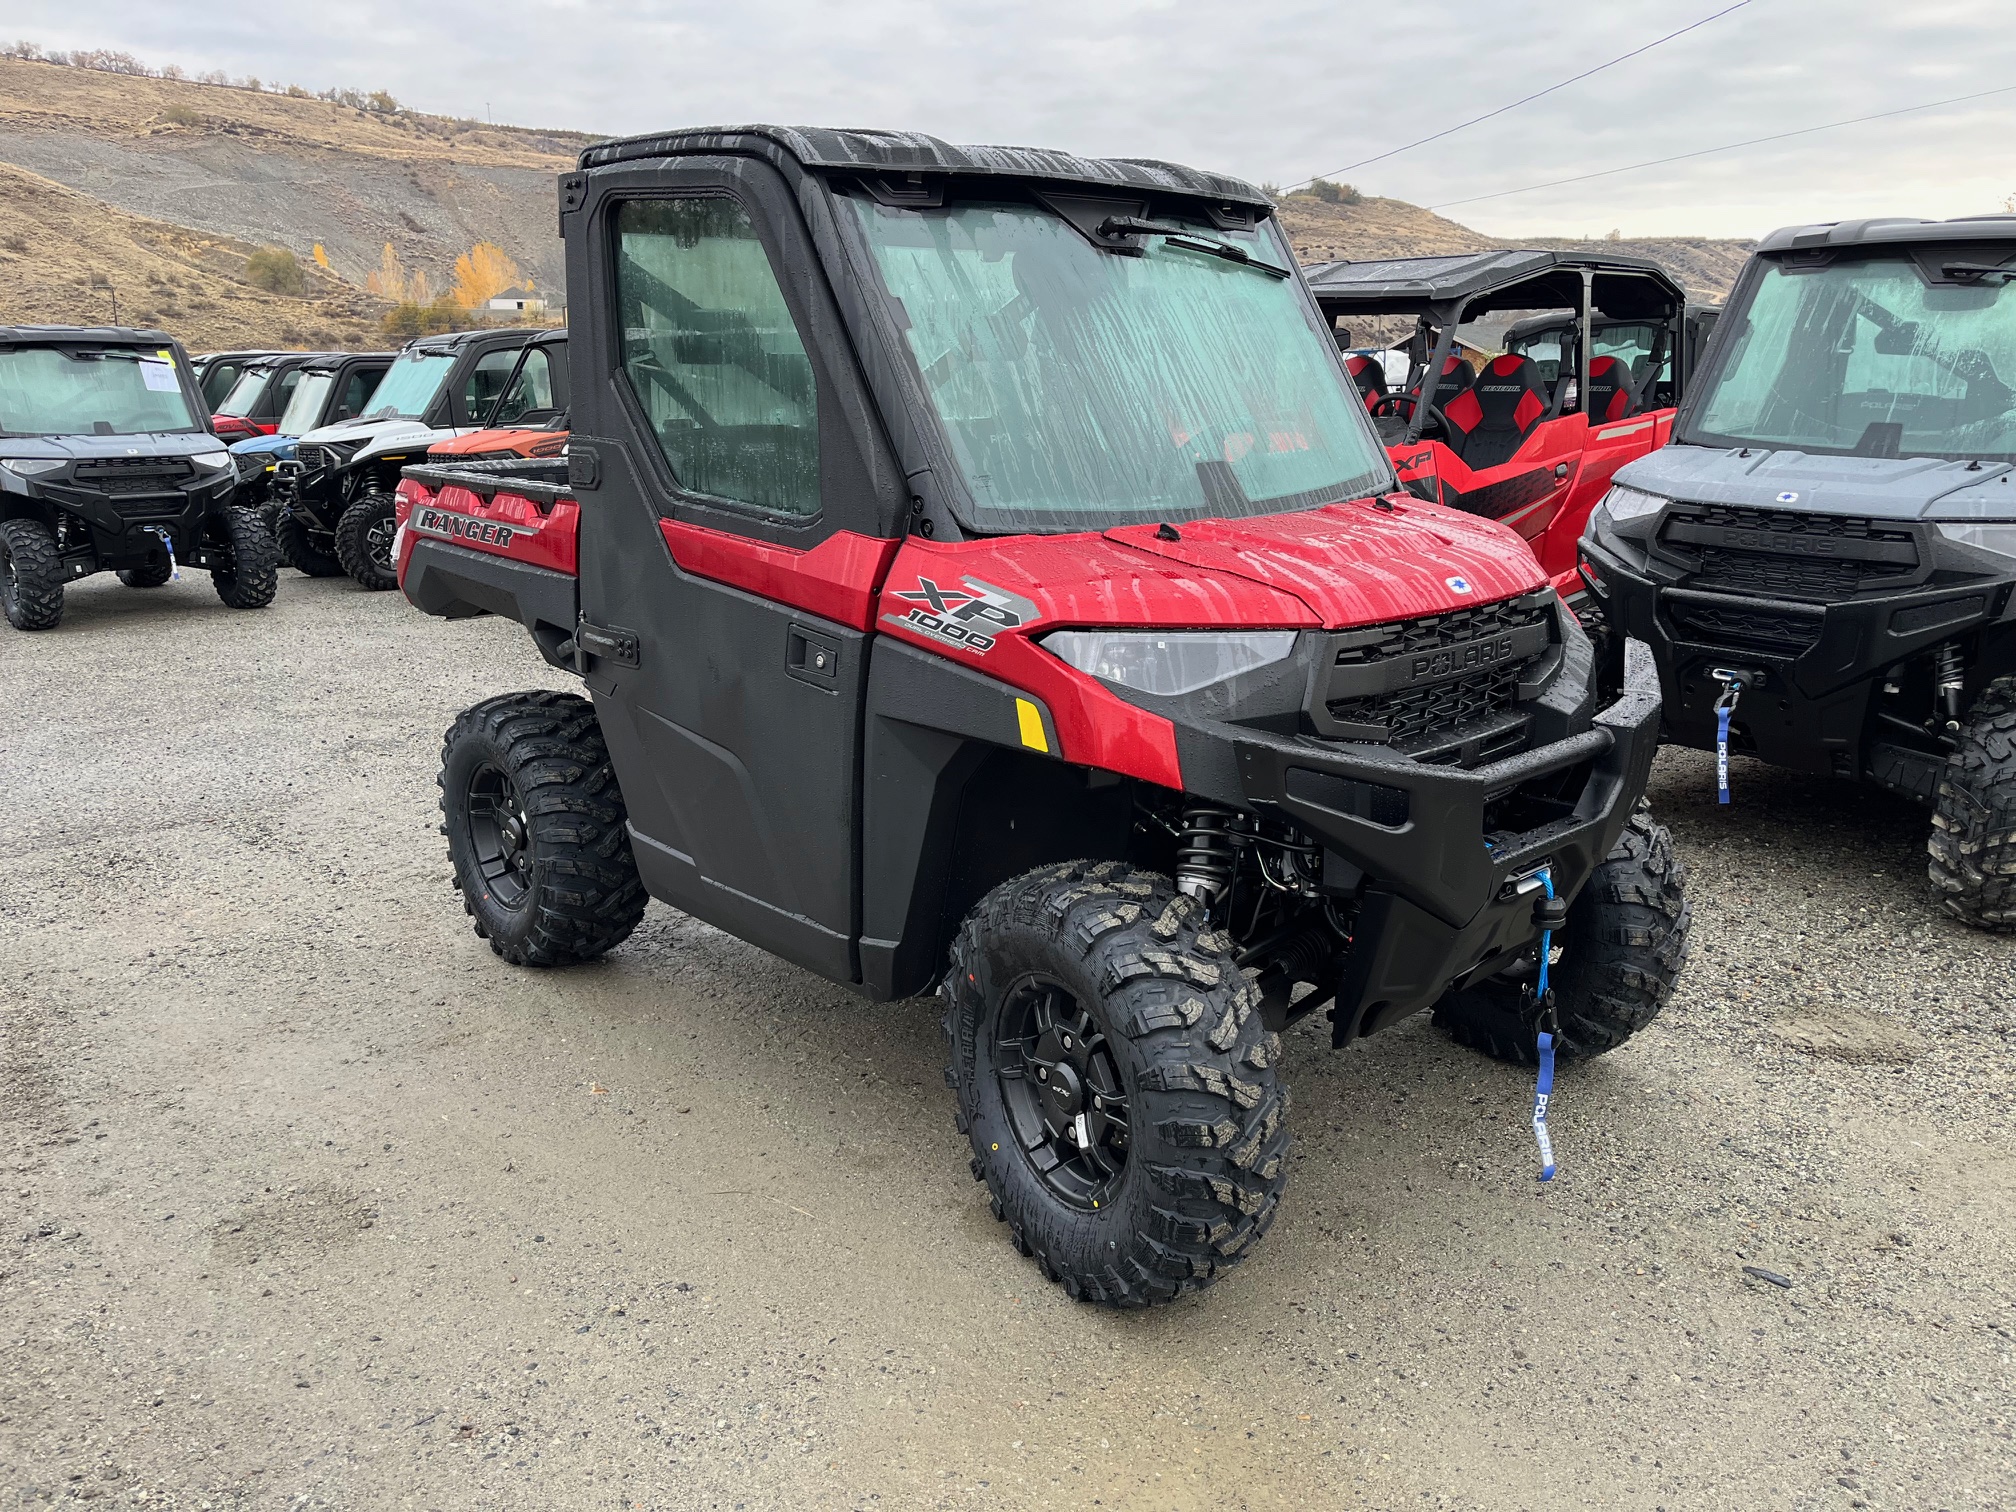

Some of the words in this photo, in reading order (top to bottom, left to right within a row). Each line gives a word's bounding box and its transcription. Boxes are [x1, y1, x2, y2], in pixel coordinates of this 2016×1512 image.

[396, 433, 434, 441] 1500
[532, 444, 562, 454] 1000
[109, 467, 163, 475] POLARIS
[1394, 450, 1432, 474] XP
[419, 508, 514, 549] RANGER
[1723, 530, 1837, 555] POLARIS
[889, 575, 1022, 628] XP
[904, 622, 924, 633] DUAL
[924, 630, 966, 649] OVERHEAD
[966, 647, 986, 657] CAM
[906, 607, 996, 652] 1000
[1411, 635, 1514, 681] POLARIS
[1718, 741, 1728, 790] POLARIS
[1532, 1093, 1554, 1168] POLARIS
